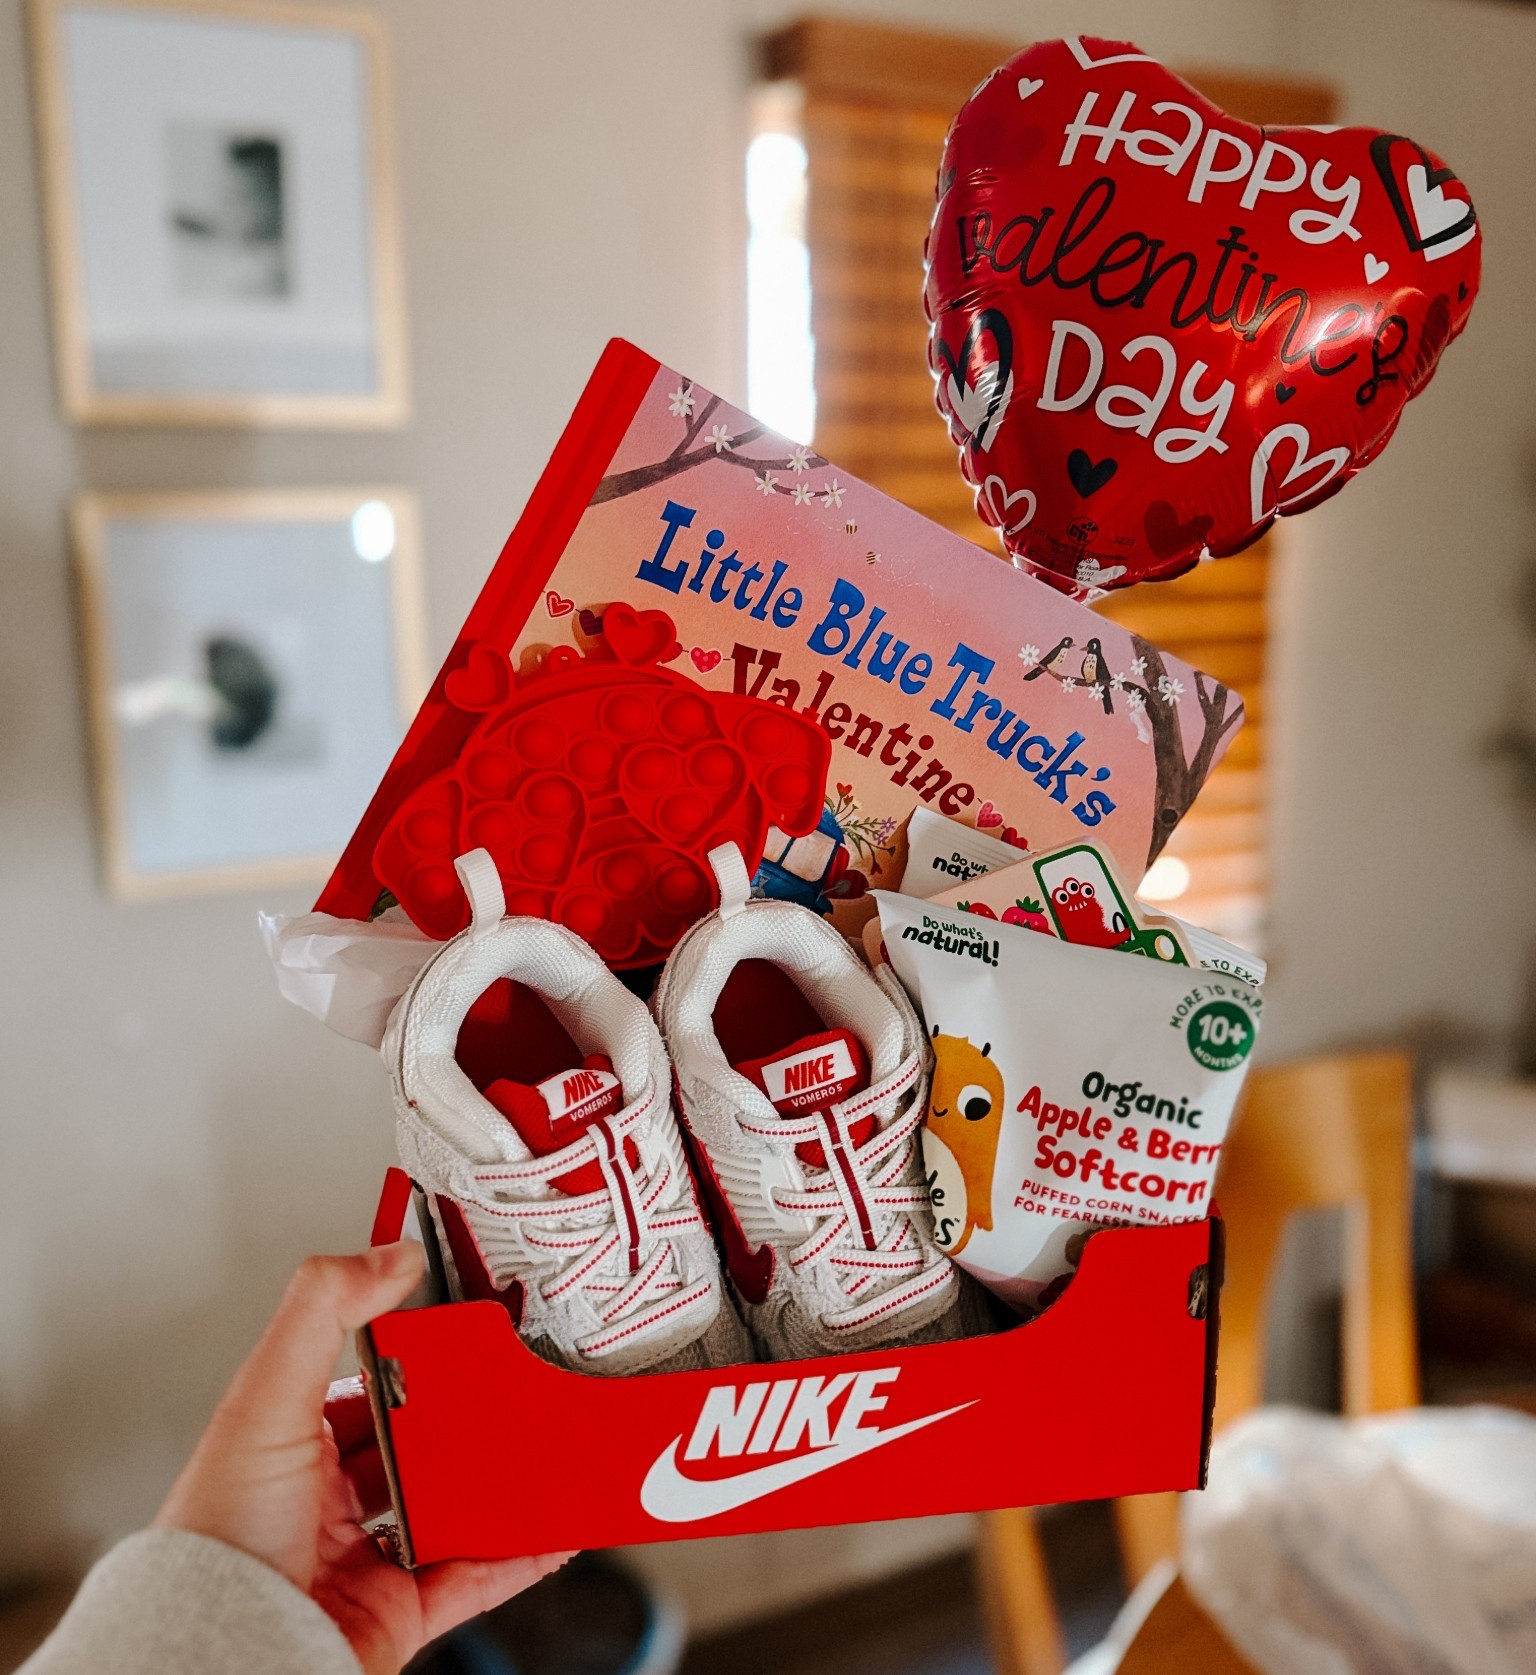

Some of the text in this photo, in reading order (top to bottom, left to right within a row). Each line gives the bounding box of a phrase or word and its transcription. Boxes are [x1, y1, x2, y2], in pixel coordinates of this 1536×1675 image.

[1058, 90, 1363, 245] Happy
[1038, 319, 1236, 464] Day
[634, 499, 1117, 827] Little Blue Truck's
[731, 642, 976, 816] Valentine
[951, 852, 967, 865] Do
[902, 926, 1000, 967] natural!
[923, 915, 984, 941] Do what's
[1211, 959, 1230, 971] TO
[1169, 988, 1204, 1029] MORE
[1204, 985, 1225, 996] TO
[1198, 1013, 1248, 1046] 10+
[784, 1053, 835, 1094] NIKE
[1193, 1045, 1244, 1068] MONTHS
[562, 1071, 605, 1109] NIKE
[1081, 1071, 1204, 1130] Organic
[1016, 1085, 1113, 1140] Apple
[1117, 1126, 1140, 1153] &
[1033, 1134, 1208, 1205] Softcorn
[1013, 1195, 1132, 1228] FOR FEARLESS
[1021, 1179, 1081, 1206] PUFFED
[1086, 1197, 1134, 1215] CORN
[683, 1366, 902, 1461] NIKE
